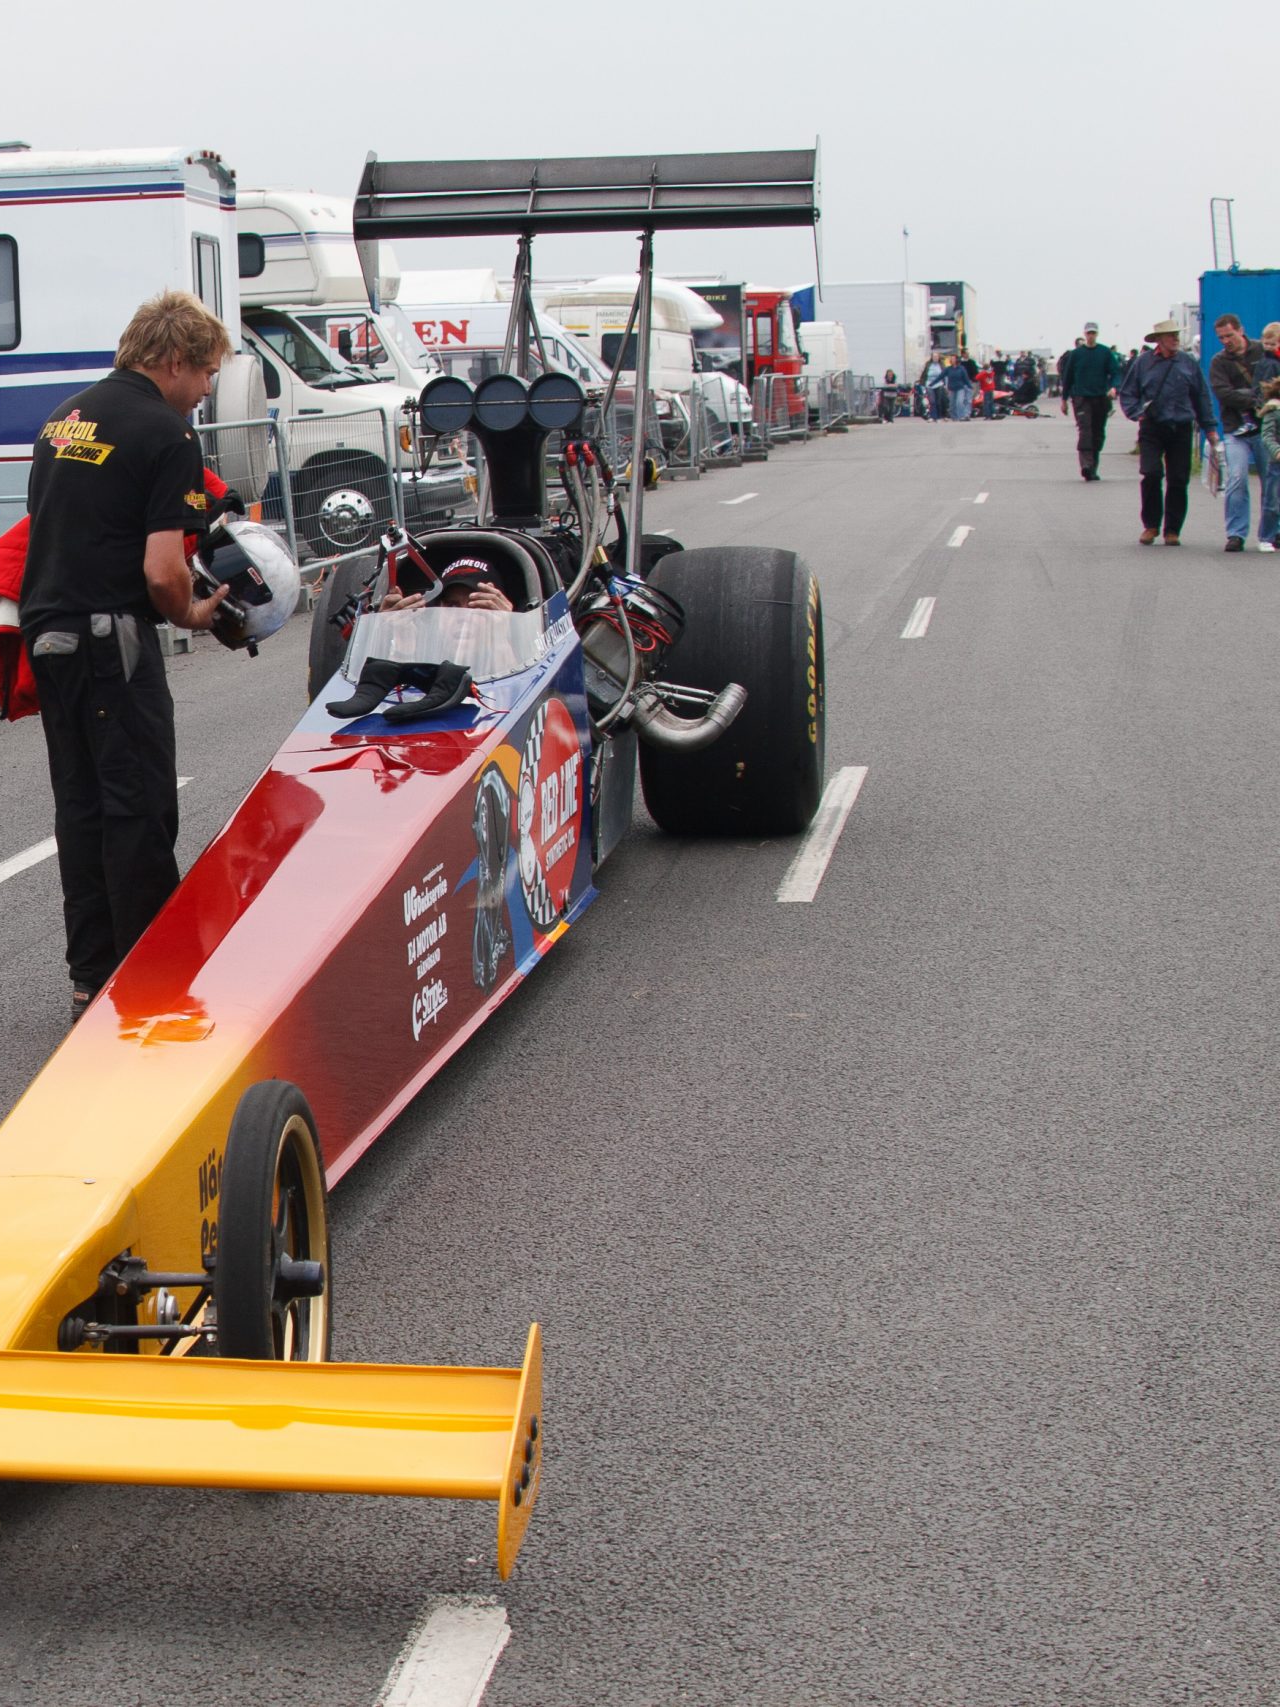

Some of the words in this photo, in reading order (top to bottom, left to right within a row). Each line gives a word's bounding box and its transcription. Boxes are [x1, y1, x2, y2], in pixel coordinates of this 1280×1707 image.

[40, 420, 98, 441] PENNZOIL
[62, 444, 102, 461] RACING
[541, 771, 559, 846] RED
[560, 752, 578, 828] LINE
[416, 920, 439, 958] MOTOR
